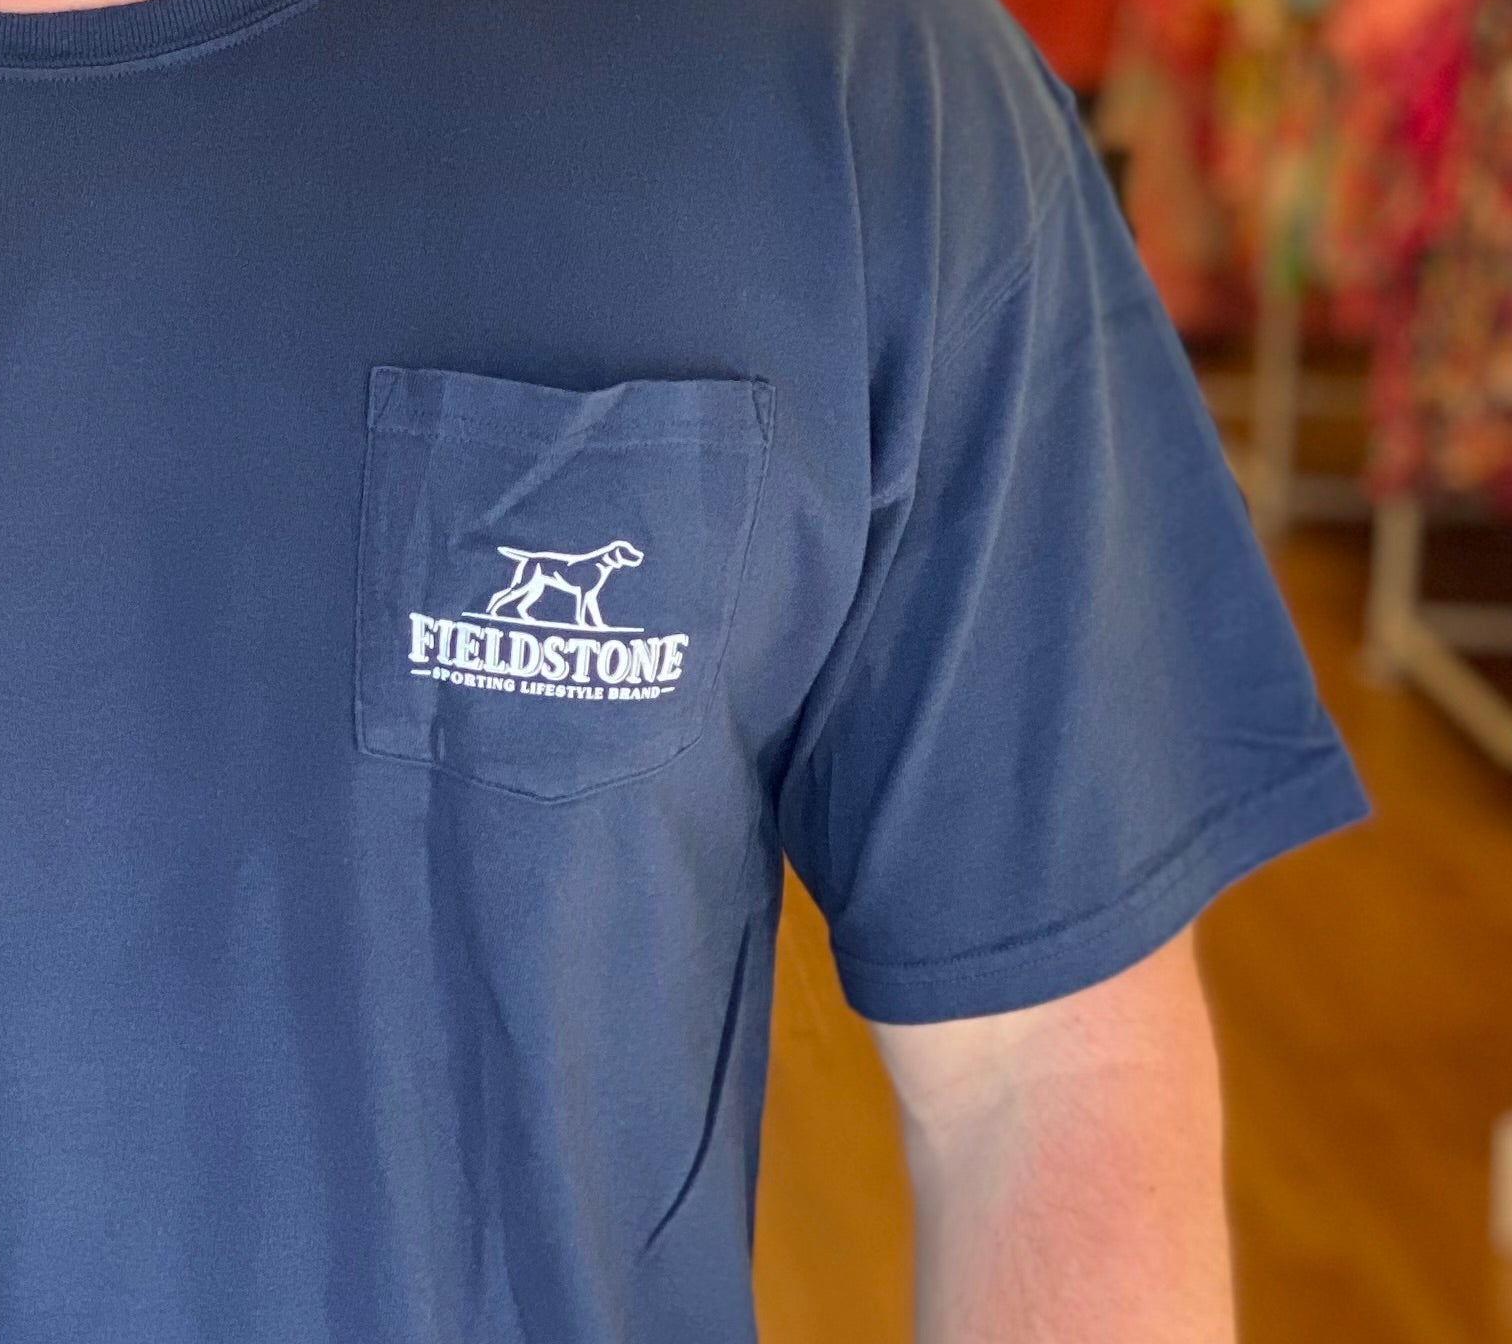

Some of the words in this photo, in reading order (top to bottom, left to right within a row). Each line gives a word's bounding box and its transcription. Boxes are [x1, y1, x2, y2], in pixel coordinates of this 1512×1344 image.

[408, 612, 689, 684] FIELDSTONE
[432, 667, 516, 692] SPORTING
[520, 680, 604, 700] LIFESTYLE
[608, 686, 660, 701] BRAND
